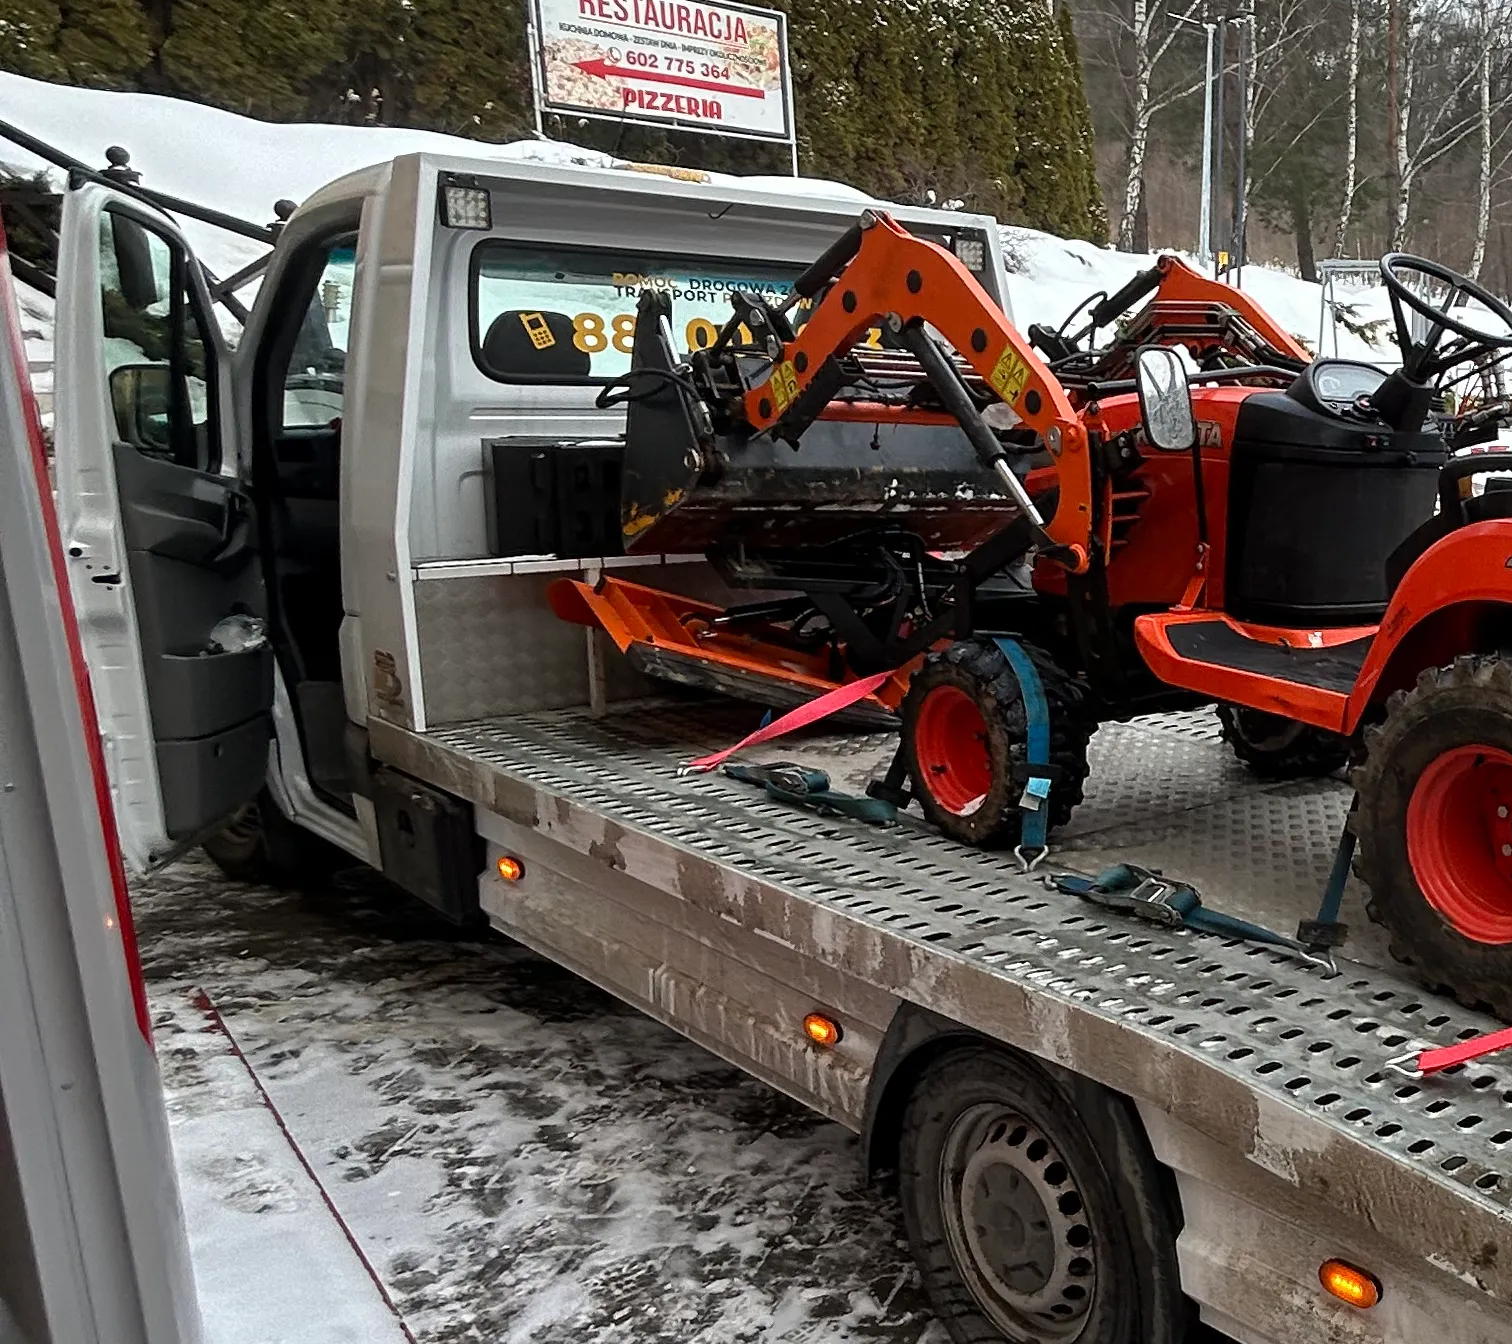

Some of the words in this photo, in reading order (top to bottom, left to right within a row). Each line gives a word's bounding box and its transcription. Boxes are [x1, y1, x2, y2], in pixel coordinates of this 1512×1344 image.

[626, 51, 659, 68] 602
[664, 56, 695, 75] 775
[700, 63, 731, 80] 364
[622, 88, 723, 120] PIZZERIA
[612, 272, 678, 289] POMOC
[689, 279, 776, 295] DROGOWA
